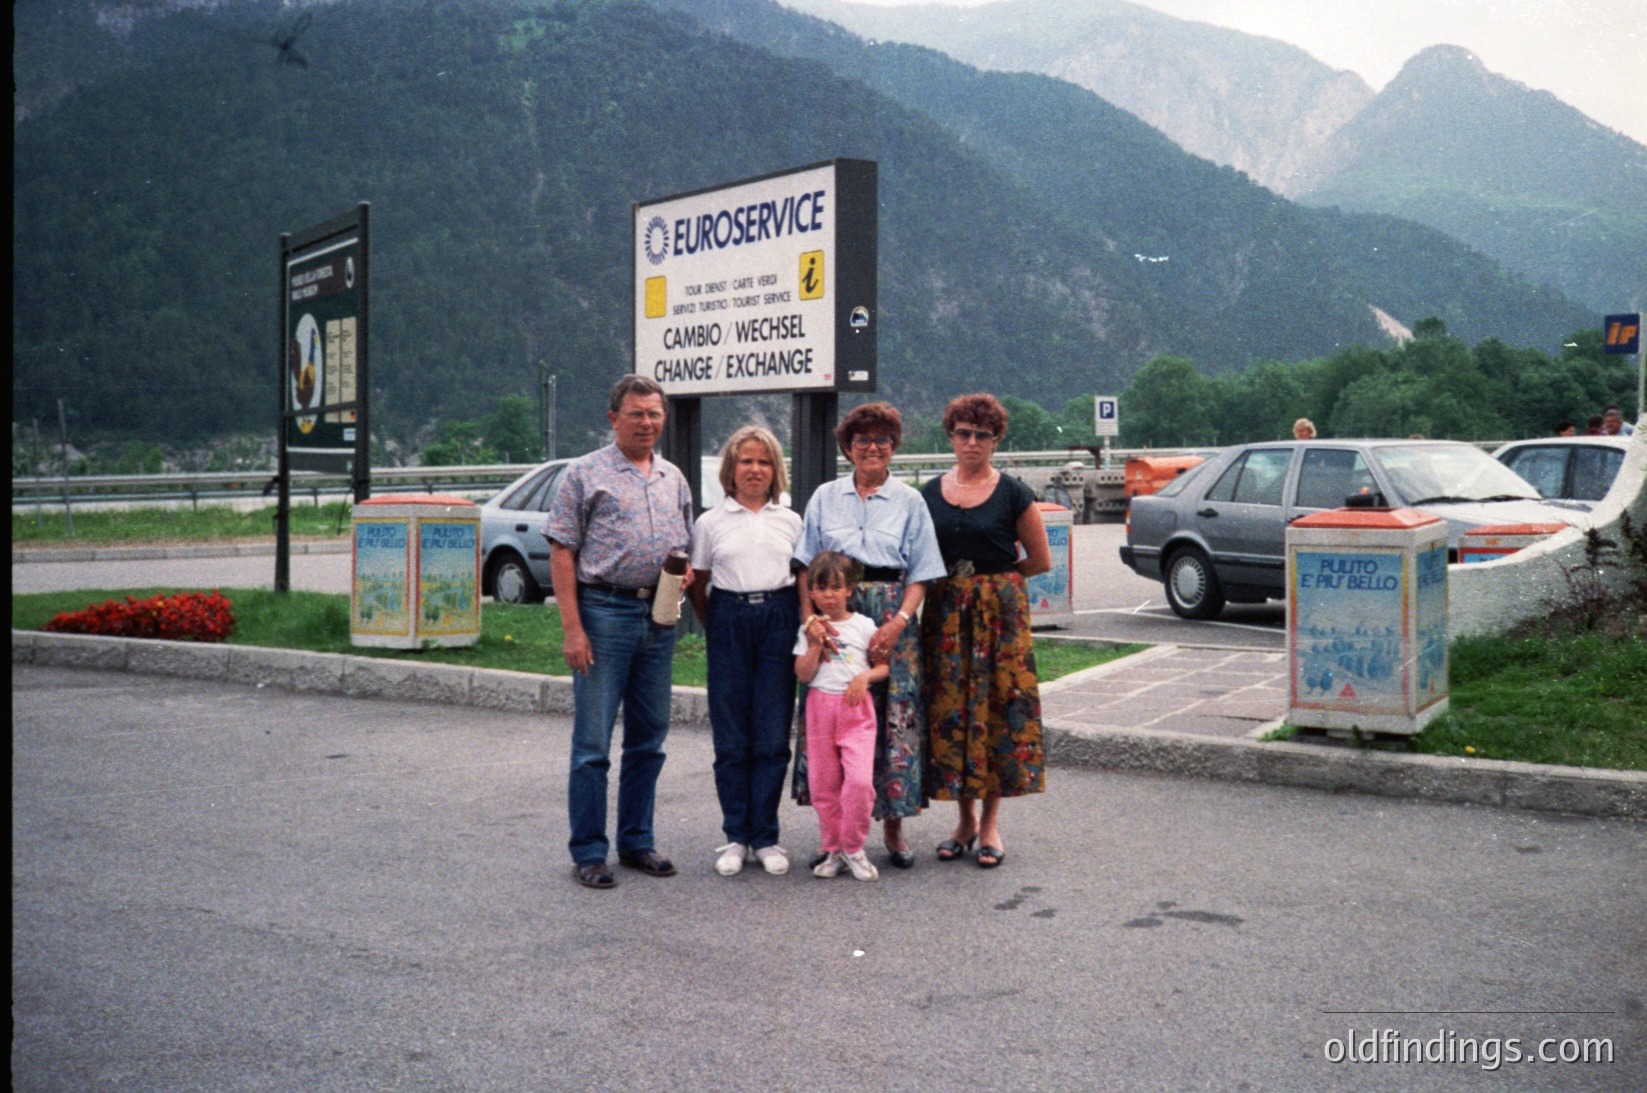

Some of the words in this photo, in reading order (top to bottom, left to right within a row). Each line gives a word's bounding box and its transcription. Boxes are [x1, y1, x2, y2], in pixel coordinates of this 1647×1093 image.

[673, 190, 825, 256] EUROSERVICE
[685, 284, 702, 296] TOUR
[733, 277, 753, 290] CARTE
[733, 295, 760, 308] TOURIST
[764, 291, 791, 304] SERVICE
[664, 323, 722, 350] CAMBIO
[736, 314, 805, 343] WECHSEL
[654, 356, 713, 383] CHANGE
[726, 348, 813, 378] EXCHANGE
[1103, 403, 1112, 417] P
[1320, 559, 1378, 575] PULITO
[1347, 575, 1398, 591] BELLO
